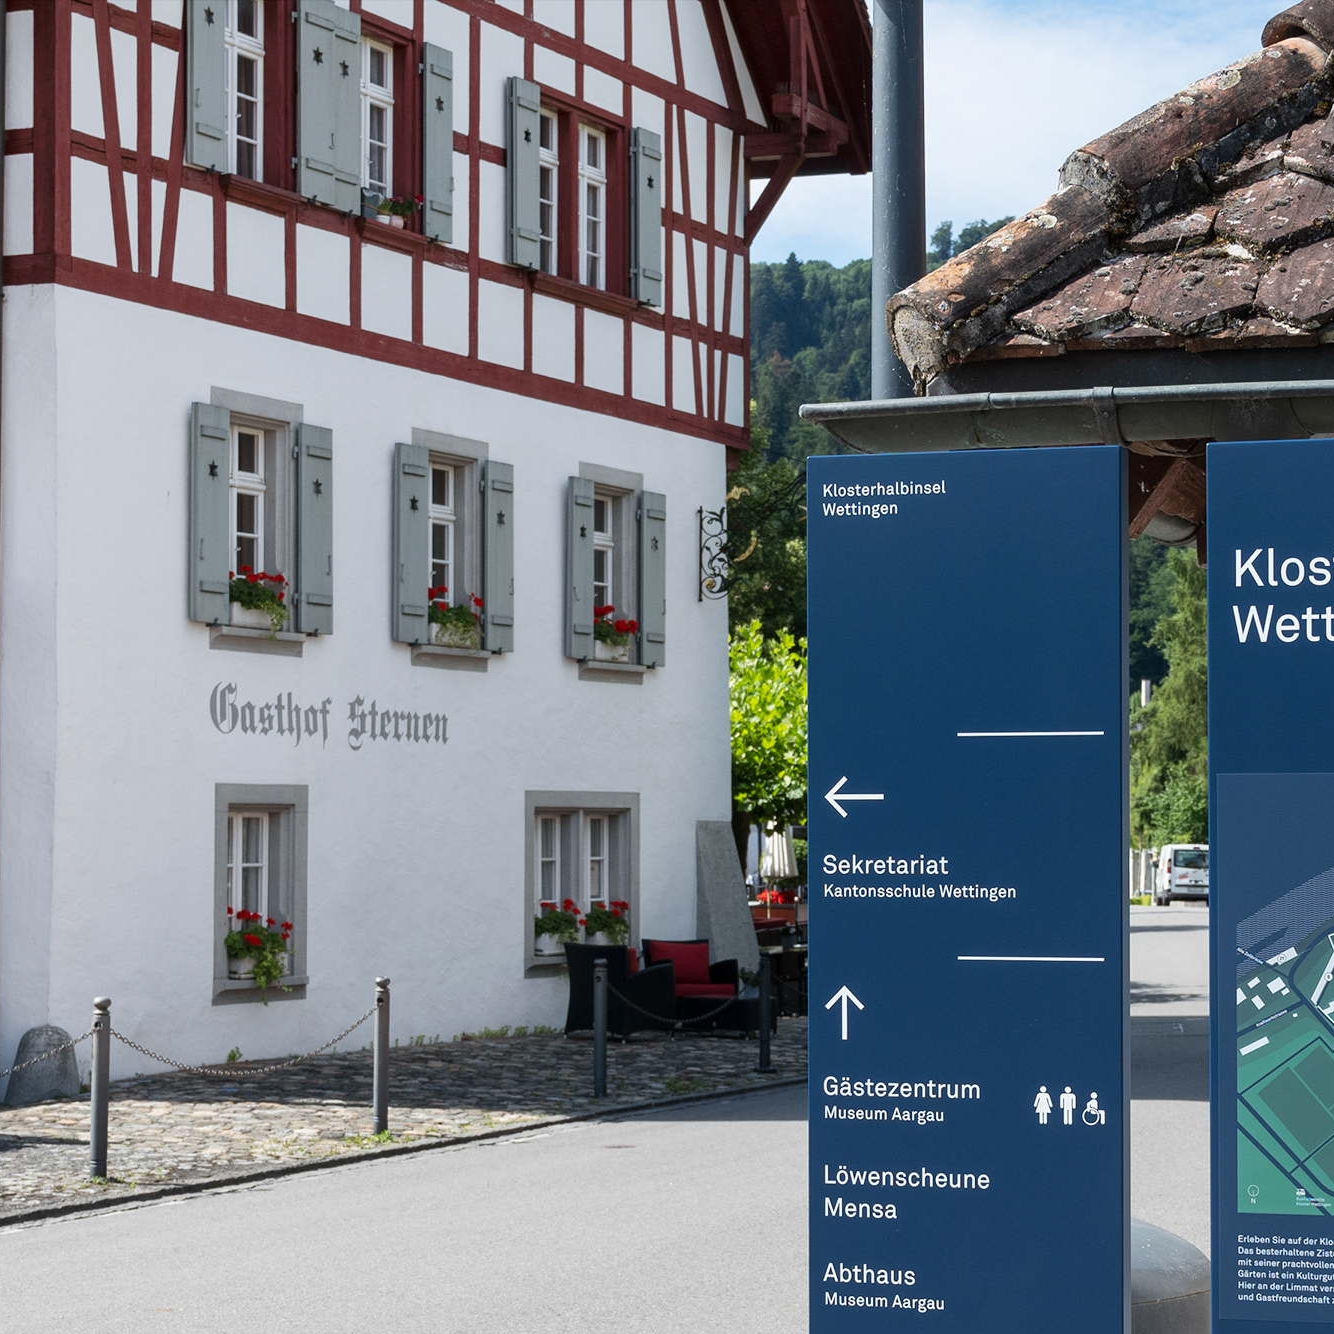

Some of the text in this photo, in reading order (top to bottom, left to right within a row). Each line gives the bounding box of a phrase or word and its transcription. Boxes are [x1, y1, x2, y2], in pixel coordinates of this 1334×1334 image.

[823, 480, 946, 497] Klosterhalbinsel
[822, 501, 898, 519] Wettingen
[209, 681, 449, 751] Gasthof Sternen
[823, 854, 949, 875] Sekretariat
[824, 883, 1016, 902] Kantonsschule Wettingen
[823, 1076, 980, 1099] Gästezentrum
[824, 1105, 944, 1125] Museum Aargau
[824, 1164, 990, 1189] Löwenscheune
[824, 1197, 897, 1219] Mensa
[1238, 1234, 1271, 1244] Erleben
[1272, 1235, 1286, 1244] Sie
[1287, 1236, 1302, 1245] auf
[1303, 1237, 1318, 1245] der
[1238, 1246, 1254, 1255] Das
[1255, 1247, 1315, 1257] besterhaltene
[1238, 1258, 1252, 1266] mit
[1254, 1258, 1280, 1267] seiner
[1282, 1260, 1334, 1269] prachtvollen
[823, 1262, 916, 1285] Abthaus
[1237, 1269, 1267, 1278] Gärten
[1268, 1270, 1280, 1279] ist
[1281, 1271, 1295, 1279] ein
[1238, 1281, 1256, 1289] Hier
[1269, 1282, 1285, 1291] der
[1286, 1283, 1318, 1292] Limmat
[825, 1291, 944, 1313] Museum Aargau
[1238, 1293, 1254, 1301] und
[1255, 1293, 1330, 1304] Gastfreundschaft
